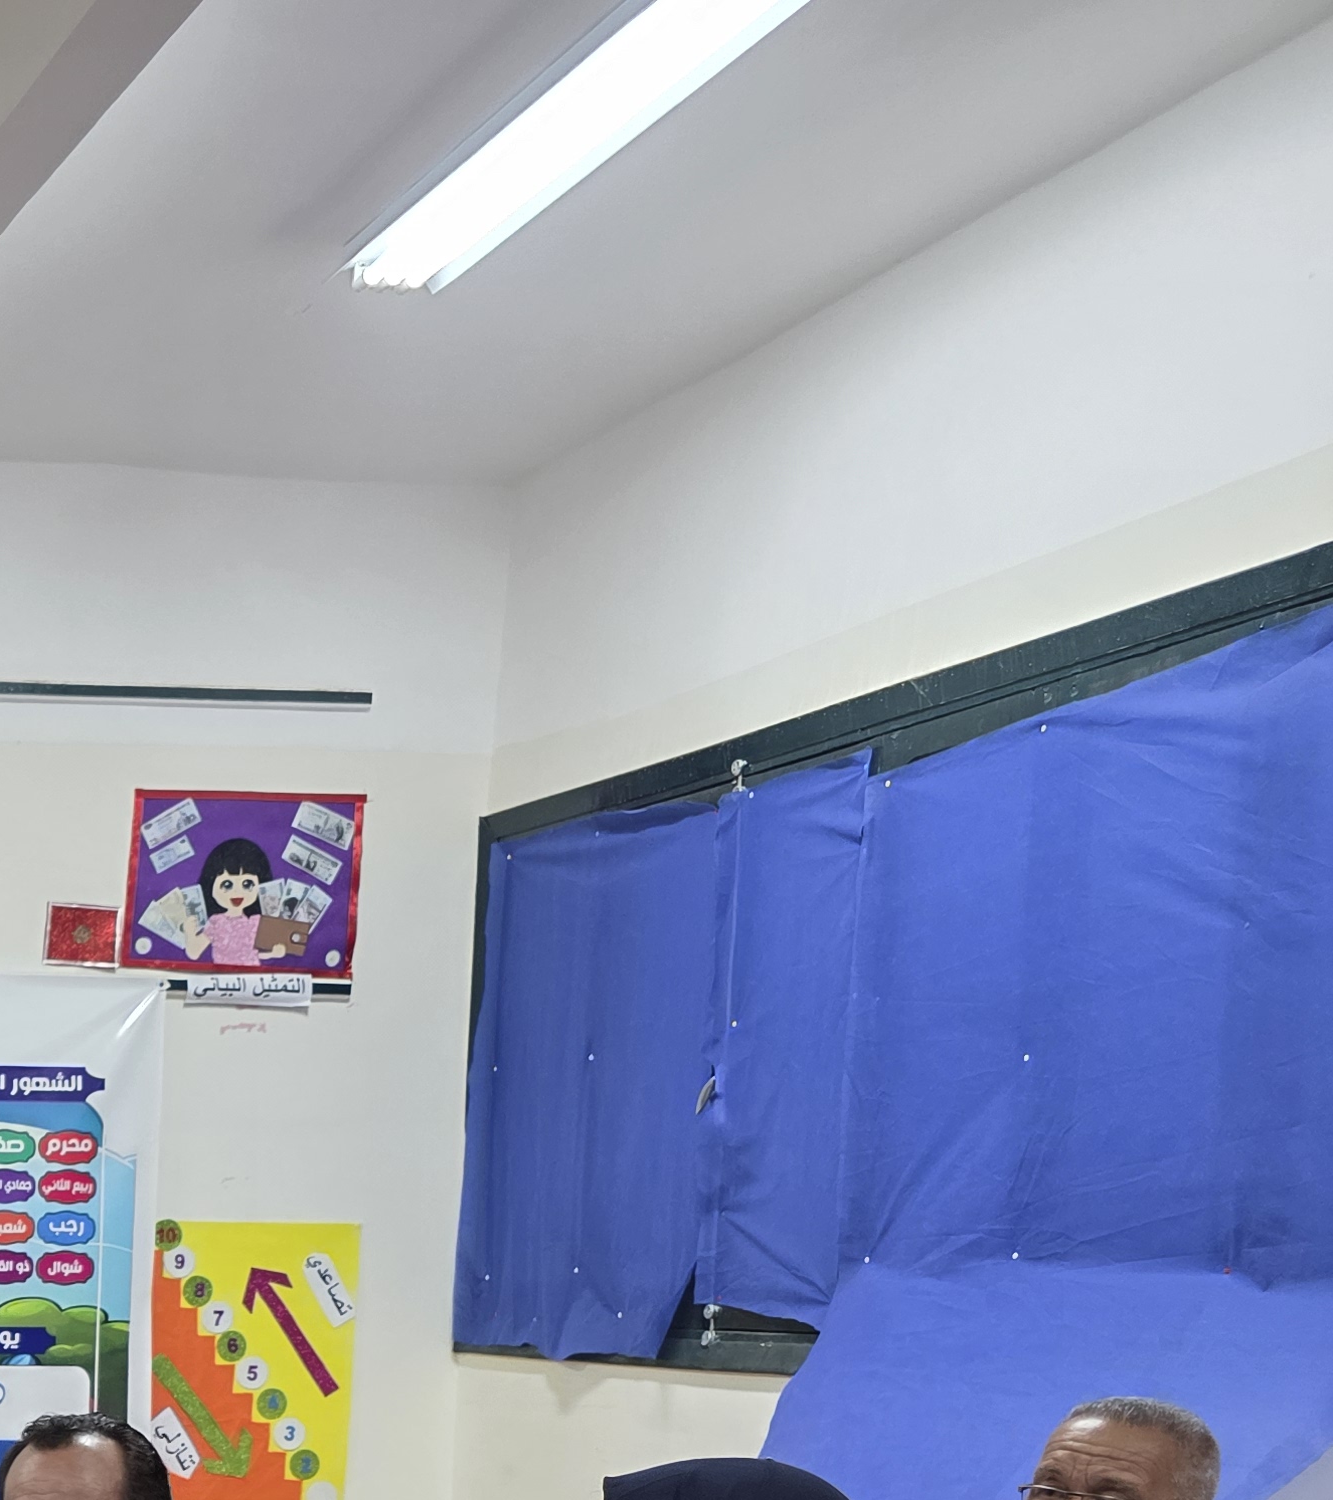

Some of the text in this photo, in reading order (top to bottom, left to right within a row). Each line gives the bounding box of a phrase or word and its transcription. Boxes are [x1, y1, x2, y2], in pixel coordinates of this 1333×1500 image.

[252, 976, 306, 997] التمثيل
[10, 1072, 83, 1097] الشهور
[45, 1138, 93, 1156] محرم
[72, 1180, 94, 1195] ربيع
[49, 1219, 85, 1236] رجب
[16, 1260, 30, 1275] ذو
[47, 1261, 83, 1276] شوال
[174, 1254, 185, 1269] 9
[194, 1282, 206, 1297] 8
[213, 1310, 224, 1326] 7
[227, 1338, 239, 1354] 6
[247, 1366, 258, 1381] 5
[284, 1426, 295, 1441] 3
[300, 1457, 312, 1473] 2
